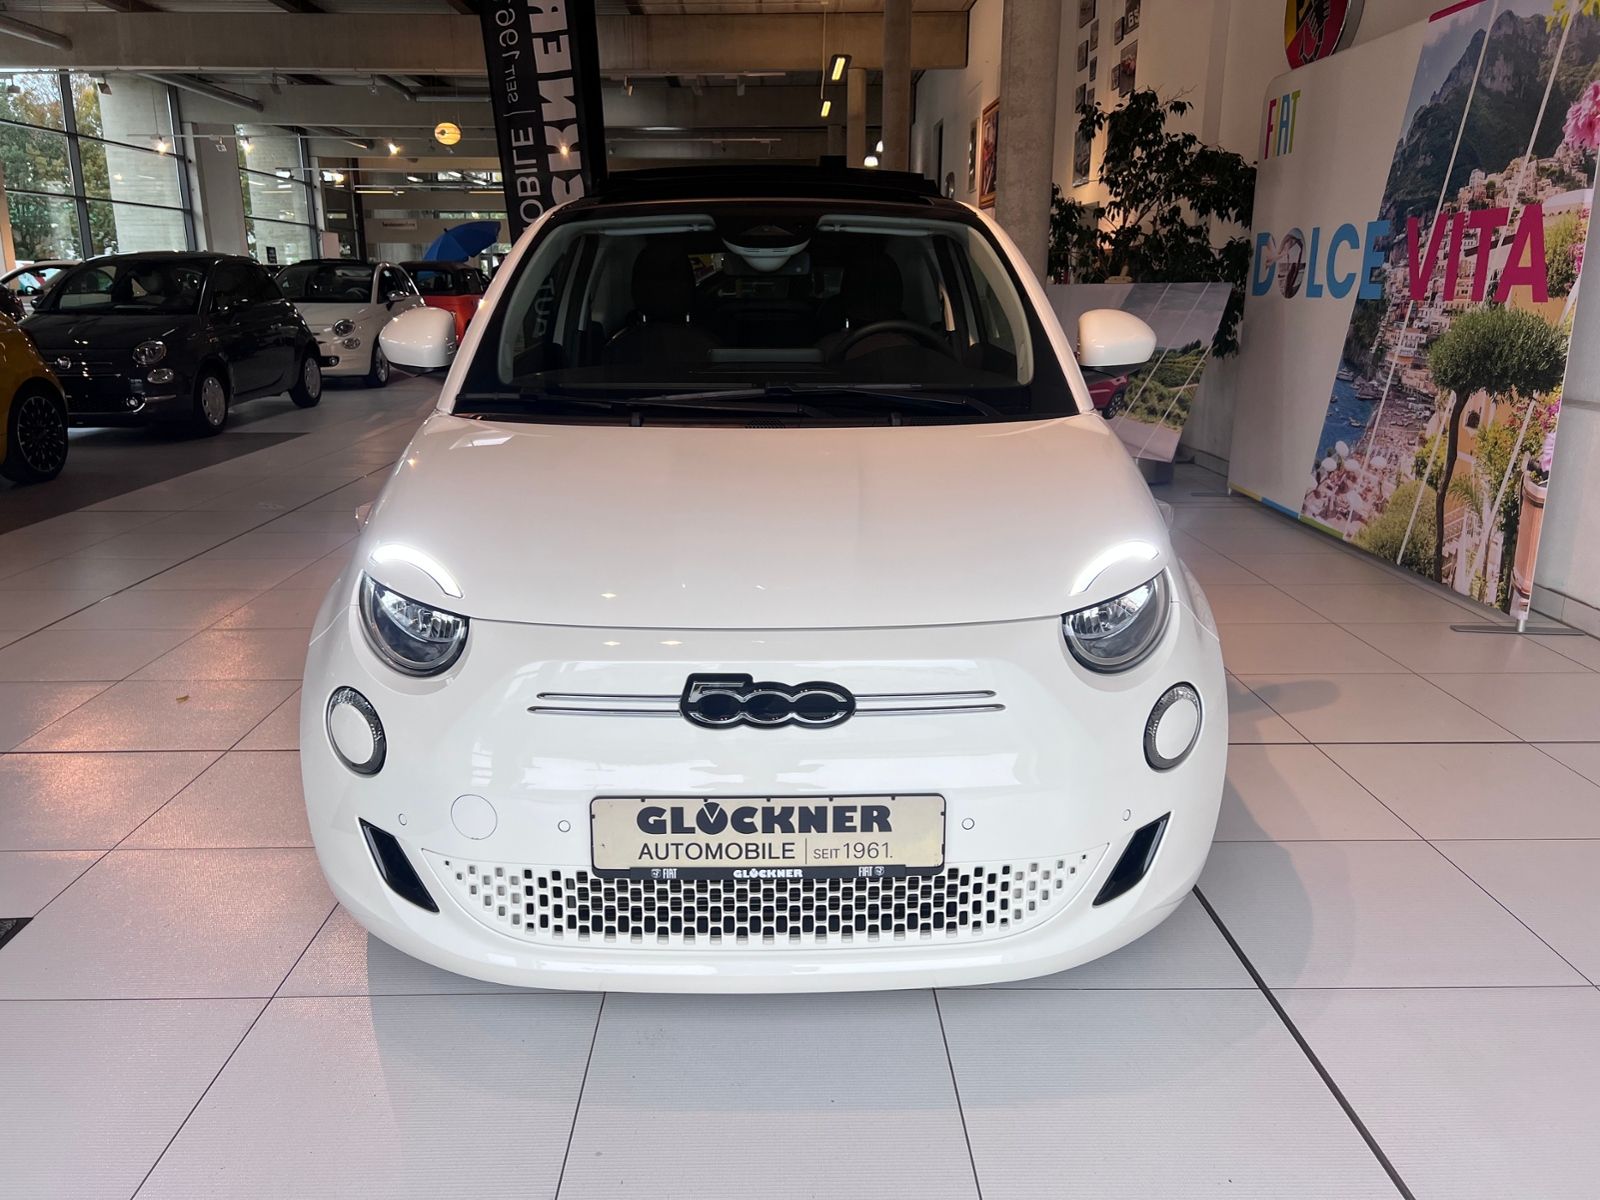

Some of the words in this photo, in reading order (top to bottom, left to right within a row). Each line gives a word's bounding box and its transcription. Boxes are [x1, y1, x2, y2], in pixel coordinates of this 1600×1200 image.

[1264, 89, 1301, 160] FIAT
[1252, 220, 1391, 300] DOLCE
[1408, 203, 1549, 303] VITA
[686, 679, 850, 726] 500
[638, 842, 796, 861] AUTOMOBILE
[812, 848, 841, 860] SEIT
[662, 868, 678, 879] FIAT
[858, 866, 873, 877] FIAT
